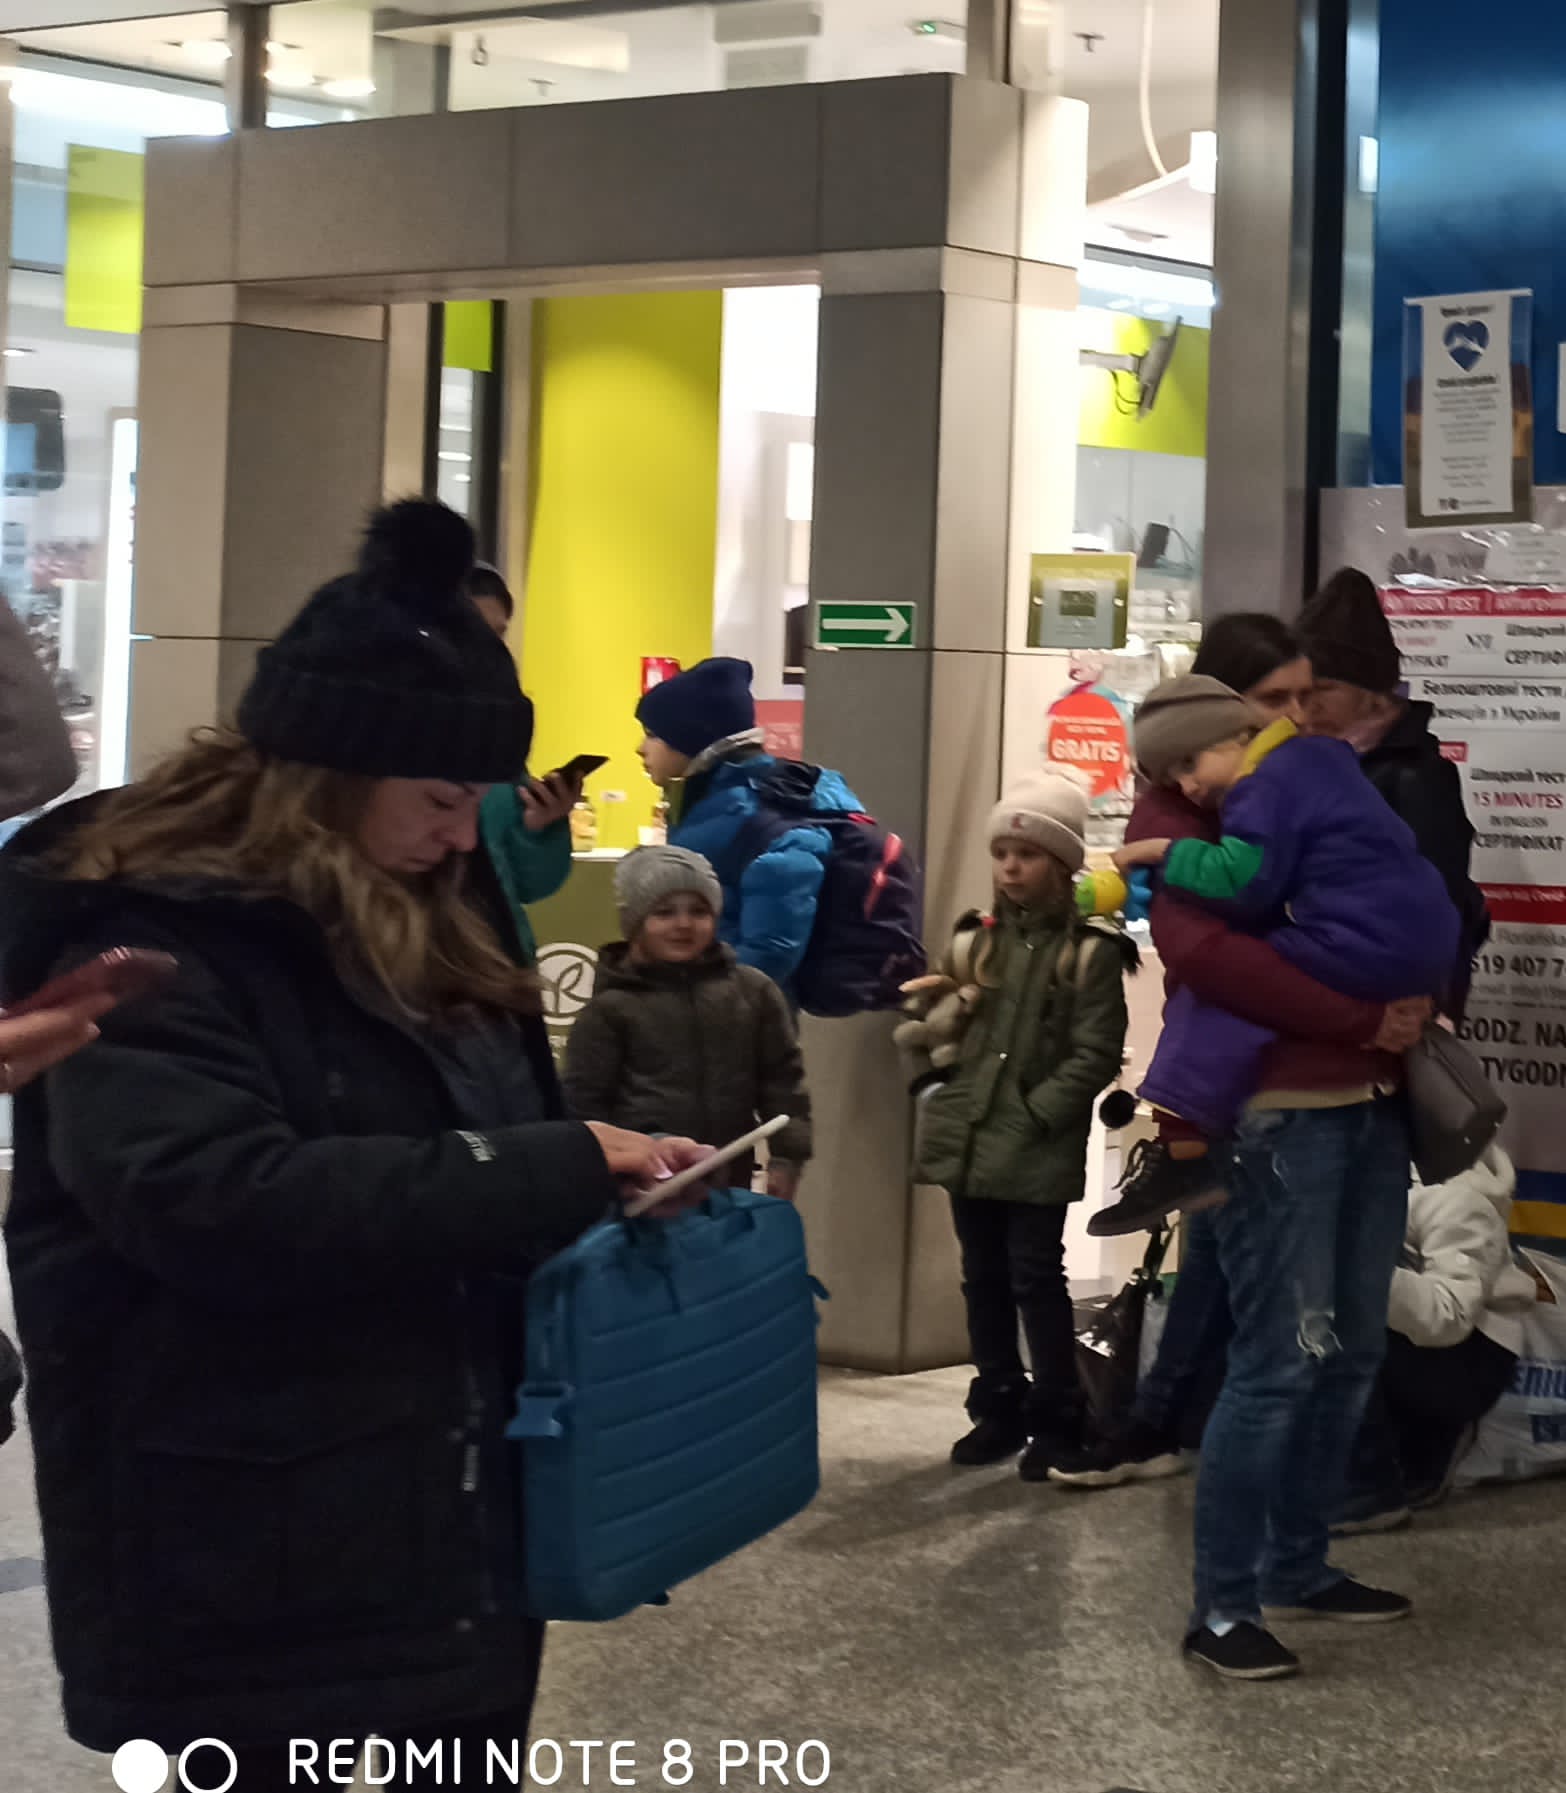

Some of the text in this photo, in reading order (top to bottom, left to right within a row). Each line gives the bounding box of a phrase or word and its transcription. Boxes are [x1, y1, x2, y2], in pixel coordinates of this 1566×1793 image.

[1051, 738, 1121, 763] GRATIS
[1494, 792, 1563, 809] MINUTES
[1510, 955, 1546, 978] 407
[1458, 1015, 1528, 1045] GODZ.
